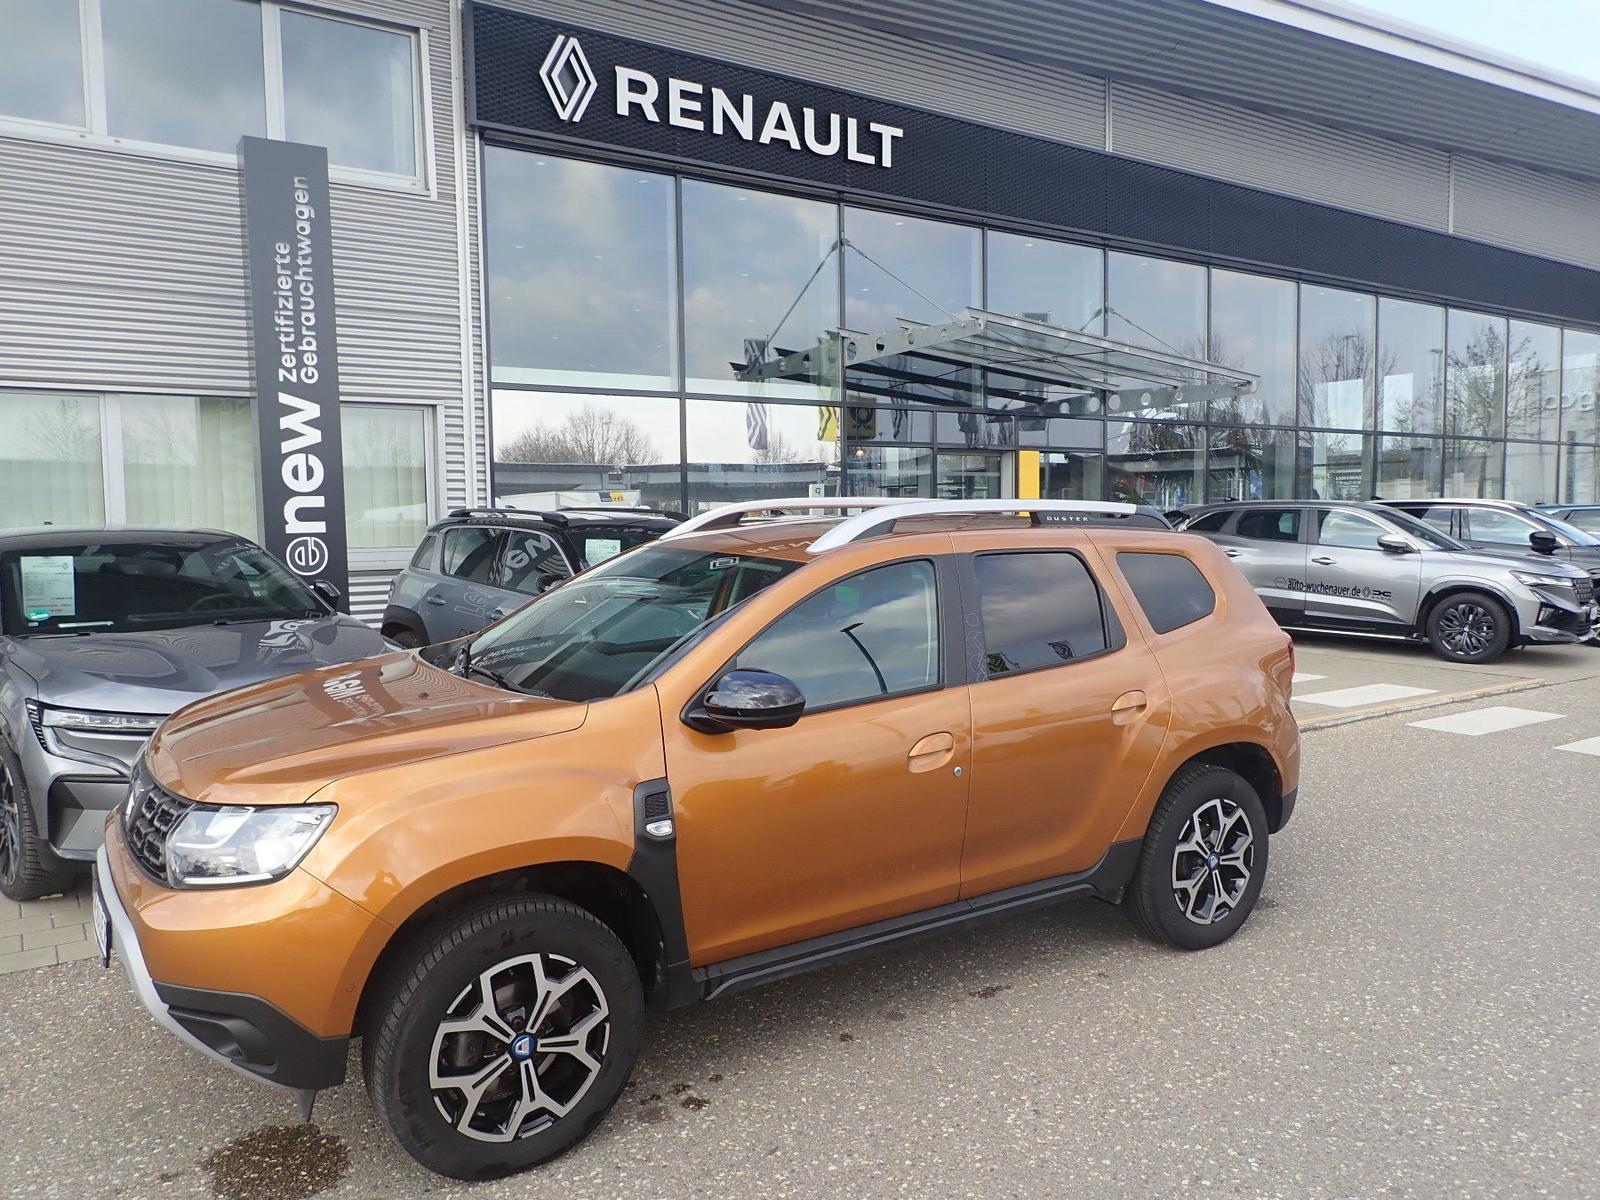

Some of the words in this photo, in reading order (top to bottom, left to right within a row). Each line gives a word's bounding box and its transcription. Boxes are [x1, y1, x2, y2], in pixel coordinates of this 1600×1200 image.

[615, 65, 904, 168] RENAULT
[273, 241, 298, 384] Zertifizierte
[293, 176, 320, 385] Gebrauchtwagen
[1287, 579, 1361, 597] auto-wuchenauer.de
